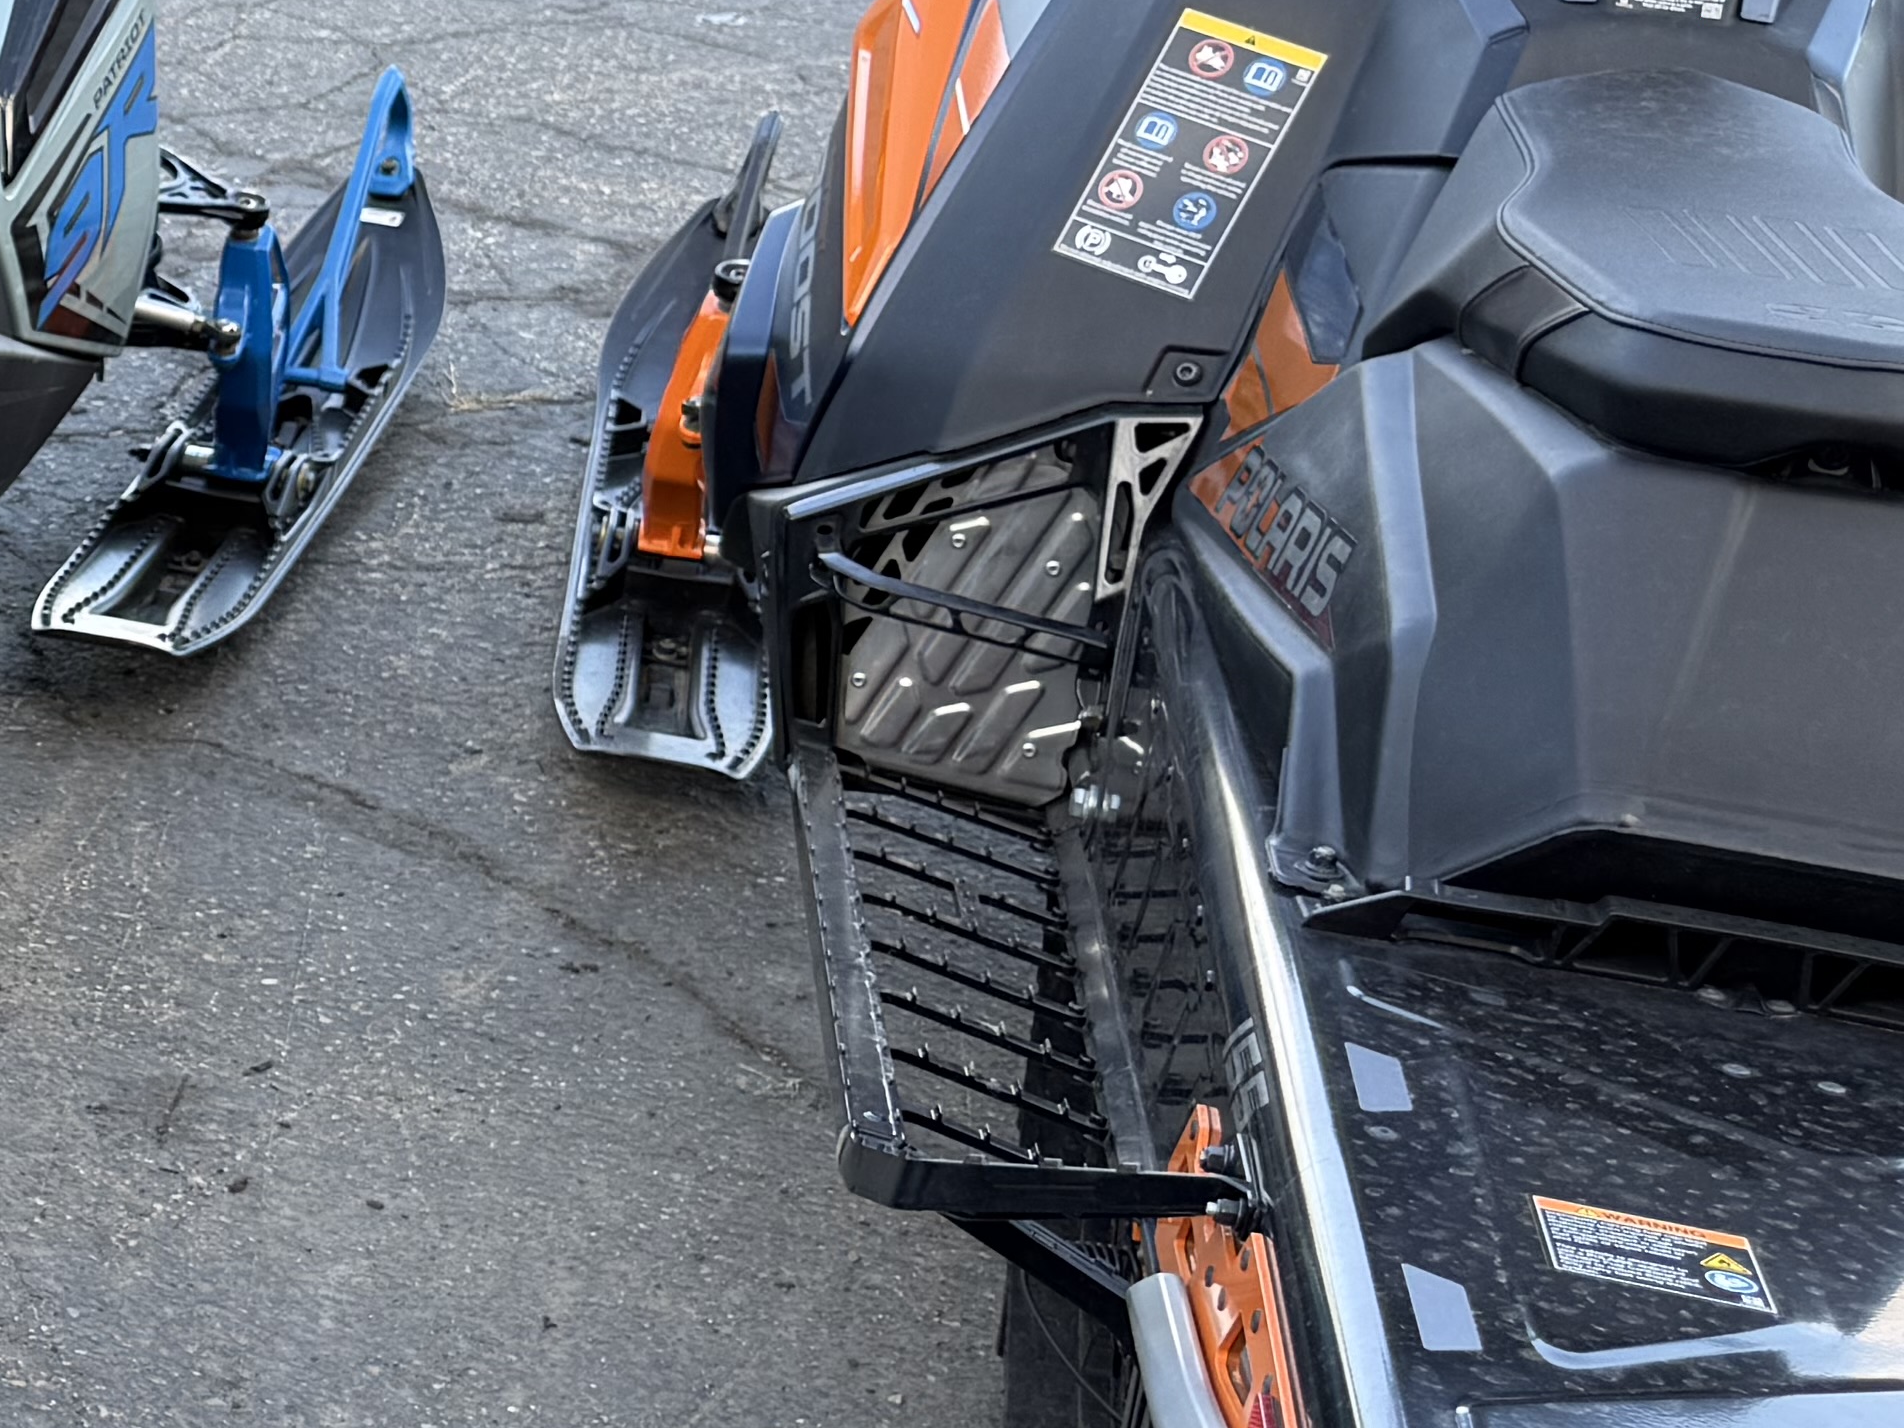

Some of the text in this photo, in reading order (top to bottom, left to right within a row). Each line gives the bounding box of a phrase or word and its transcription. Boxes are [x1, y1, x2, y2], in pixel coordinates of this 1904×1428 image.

[93, 8, 147, 111] PATRIOT
[1215, 442, 1358, 618] POLARIS
[1602, 1211, 1706, 1239] WARNING
